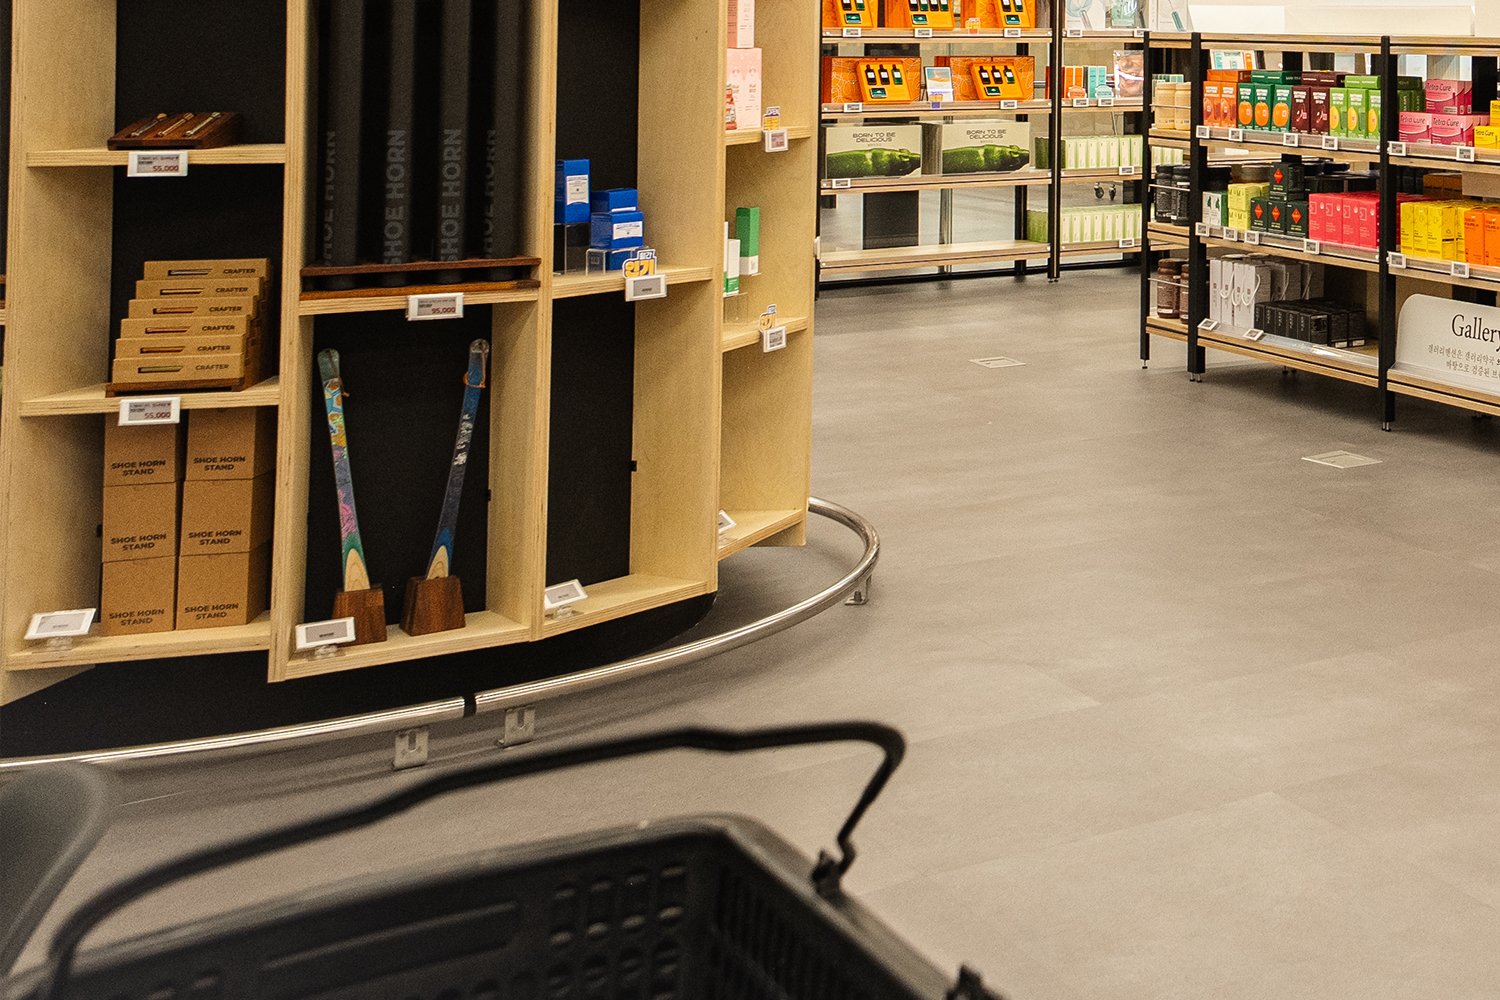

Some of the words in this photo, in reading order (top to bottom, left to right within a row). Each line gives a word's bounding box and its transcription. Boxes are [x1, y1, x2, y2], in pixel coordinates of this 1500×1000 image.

[1427, 82, 1439, 91] Tetra
[1440, 83, 1452, 92] Cure
[1414, 116, 1426, 124] Cure
[1433, 117, 1446, 126] Tetra
[1446, 119, 1459, 127] Cure
[625, 259, 654, 278] 인기
[202, 324, 235, 332] CRAFTER
[111, 461, 136, 470] SHOE
[139, 460, 166, 468] HORN
[122, 468, 154, 476] STAND
[110, 536, 136, 545] SHOE
[139, 534, 166, 542] HORN
[200, 538, 230, 546] STAND
[122, 542, 154, 551] STAND
[184, 606, 209, 614] SHOE
[212, 603, 239, 611] HORN
[109, 611, 134, 620] SHOE
[138, 608, 164, 617] HORN
[196, 612, 227, 620] STAND
[120, 618, 153, 626] STAND
